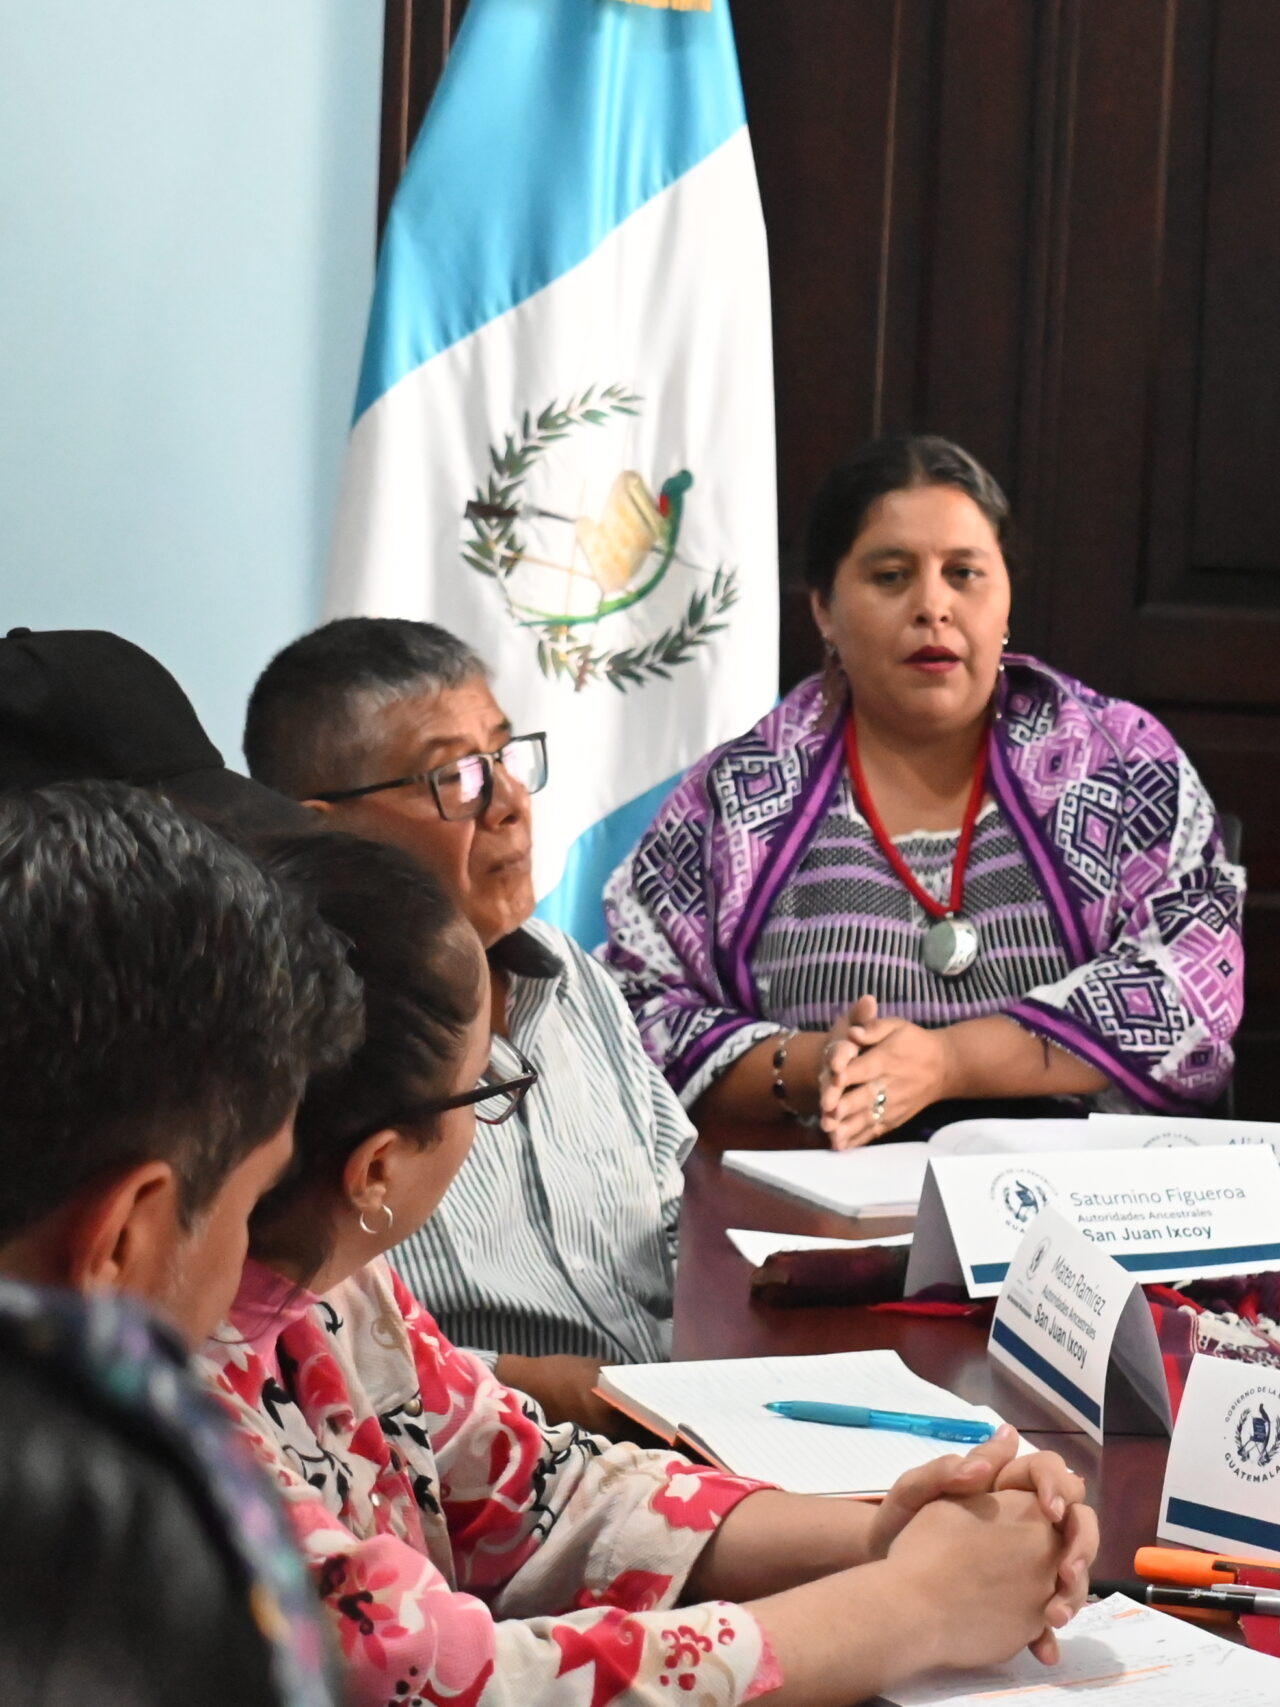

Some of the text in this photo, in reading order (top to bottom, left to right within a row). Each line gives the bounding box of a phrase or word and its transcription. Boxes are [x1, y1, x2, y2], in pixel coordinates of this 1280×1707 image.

[1070, 1185, 1246, 1207] Saturnino Figueroa
[1077, 1208, 1213, 1223] Autoridades Ancestrales
[1082, 1224, 1212, 1242] San Juan Ixcoy
[1051, 1256, 1077, 1289] Mateo
[1073, 1274, 1106, 1316] Ramírez
[1034, 1302, 1049, 1331] San
[1048, 1316, 1067, 1347] Juan
[1066, 1330, 1088, 1369] Ixcoy
[1225, 1388, 1255, 1422] GOBIERNO
